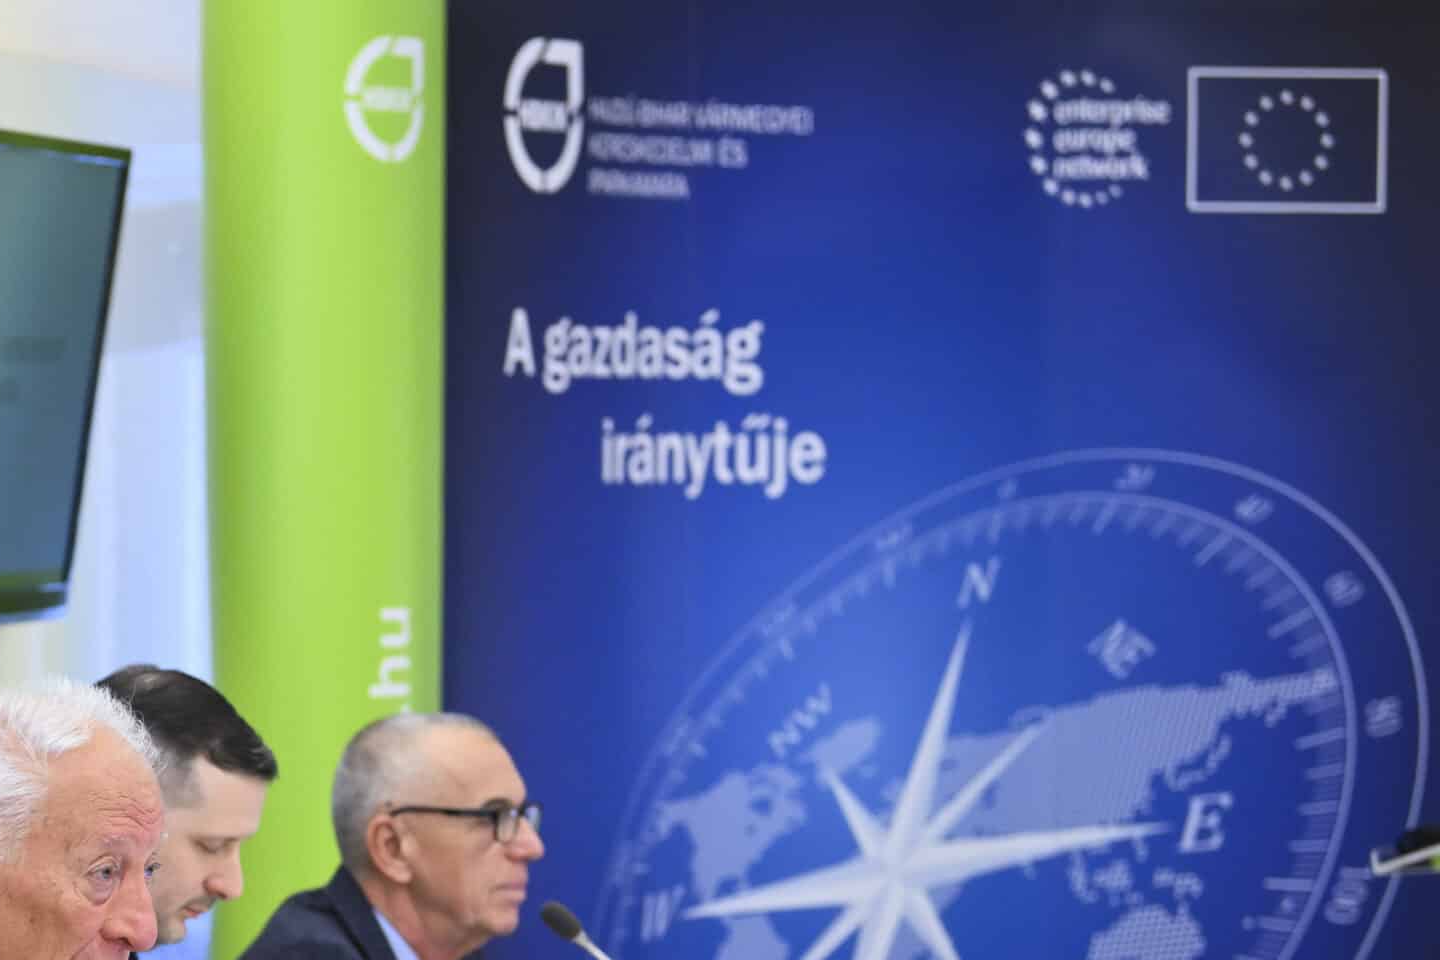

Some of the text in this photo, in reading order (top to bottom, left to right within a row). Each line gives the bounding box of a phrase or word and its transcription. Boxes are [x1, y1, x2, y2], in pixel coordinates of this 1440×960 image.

[503, 307, 764, 396] A gazdaság
[600, 412, 827, 500] iránytűje
[957, 555, 1001, 608] N
[1178, 791, 1233, 854] E
